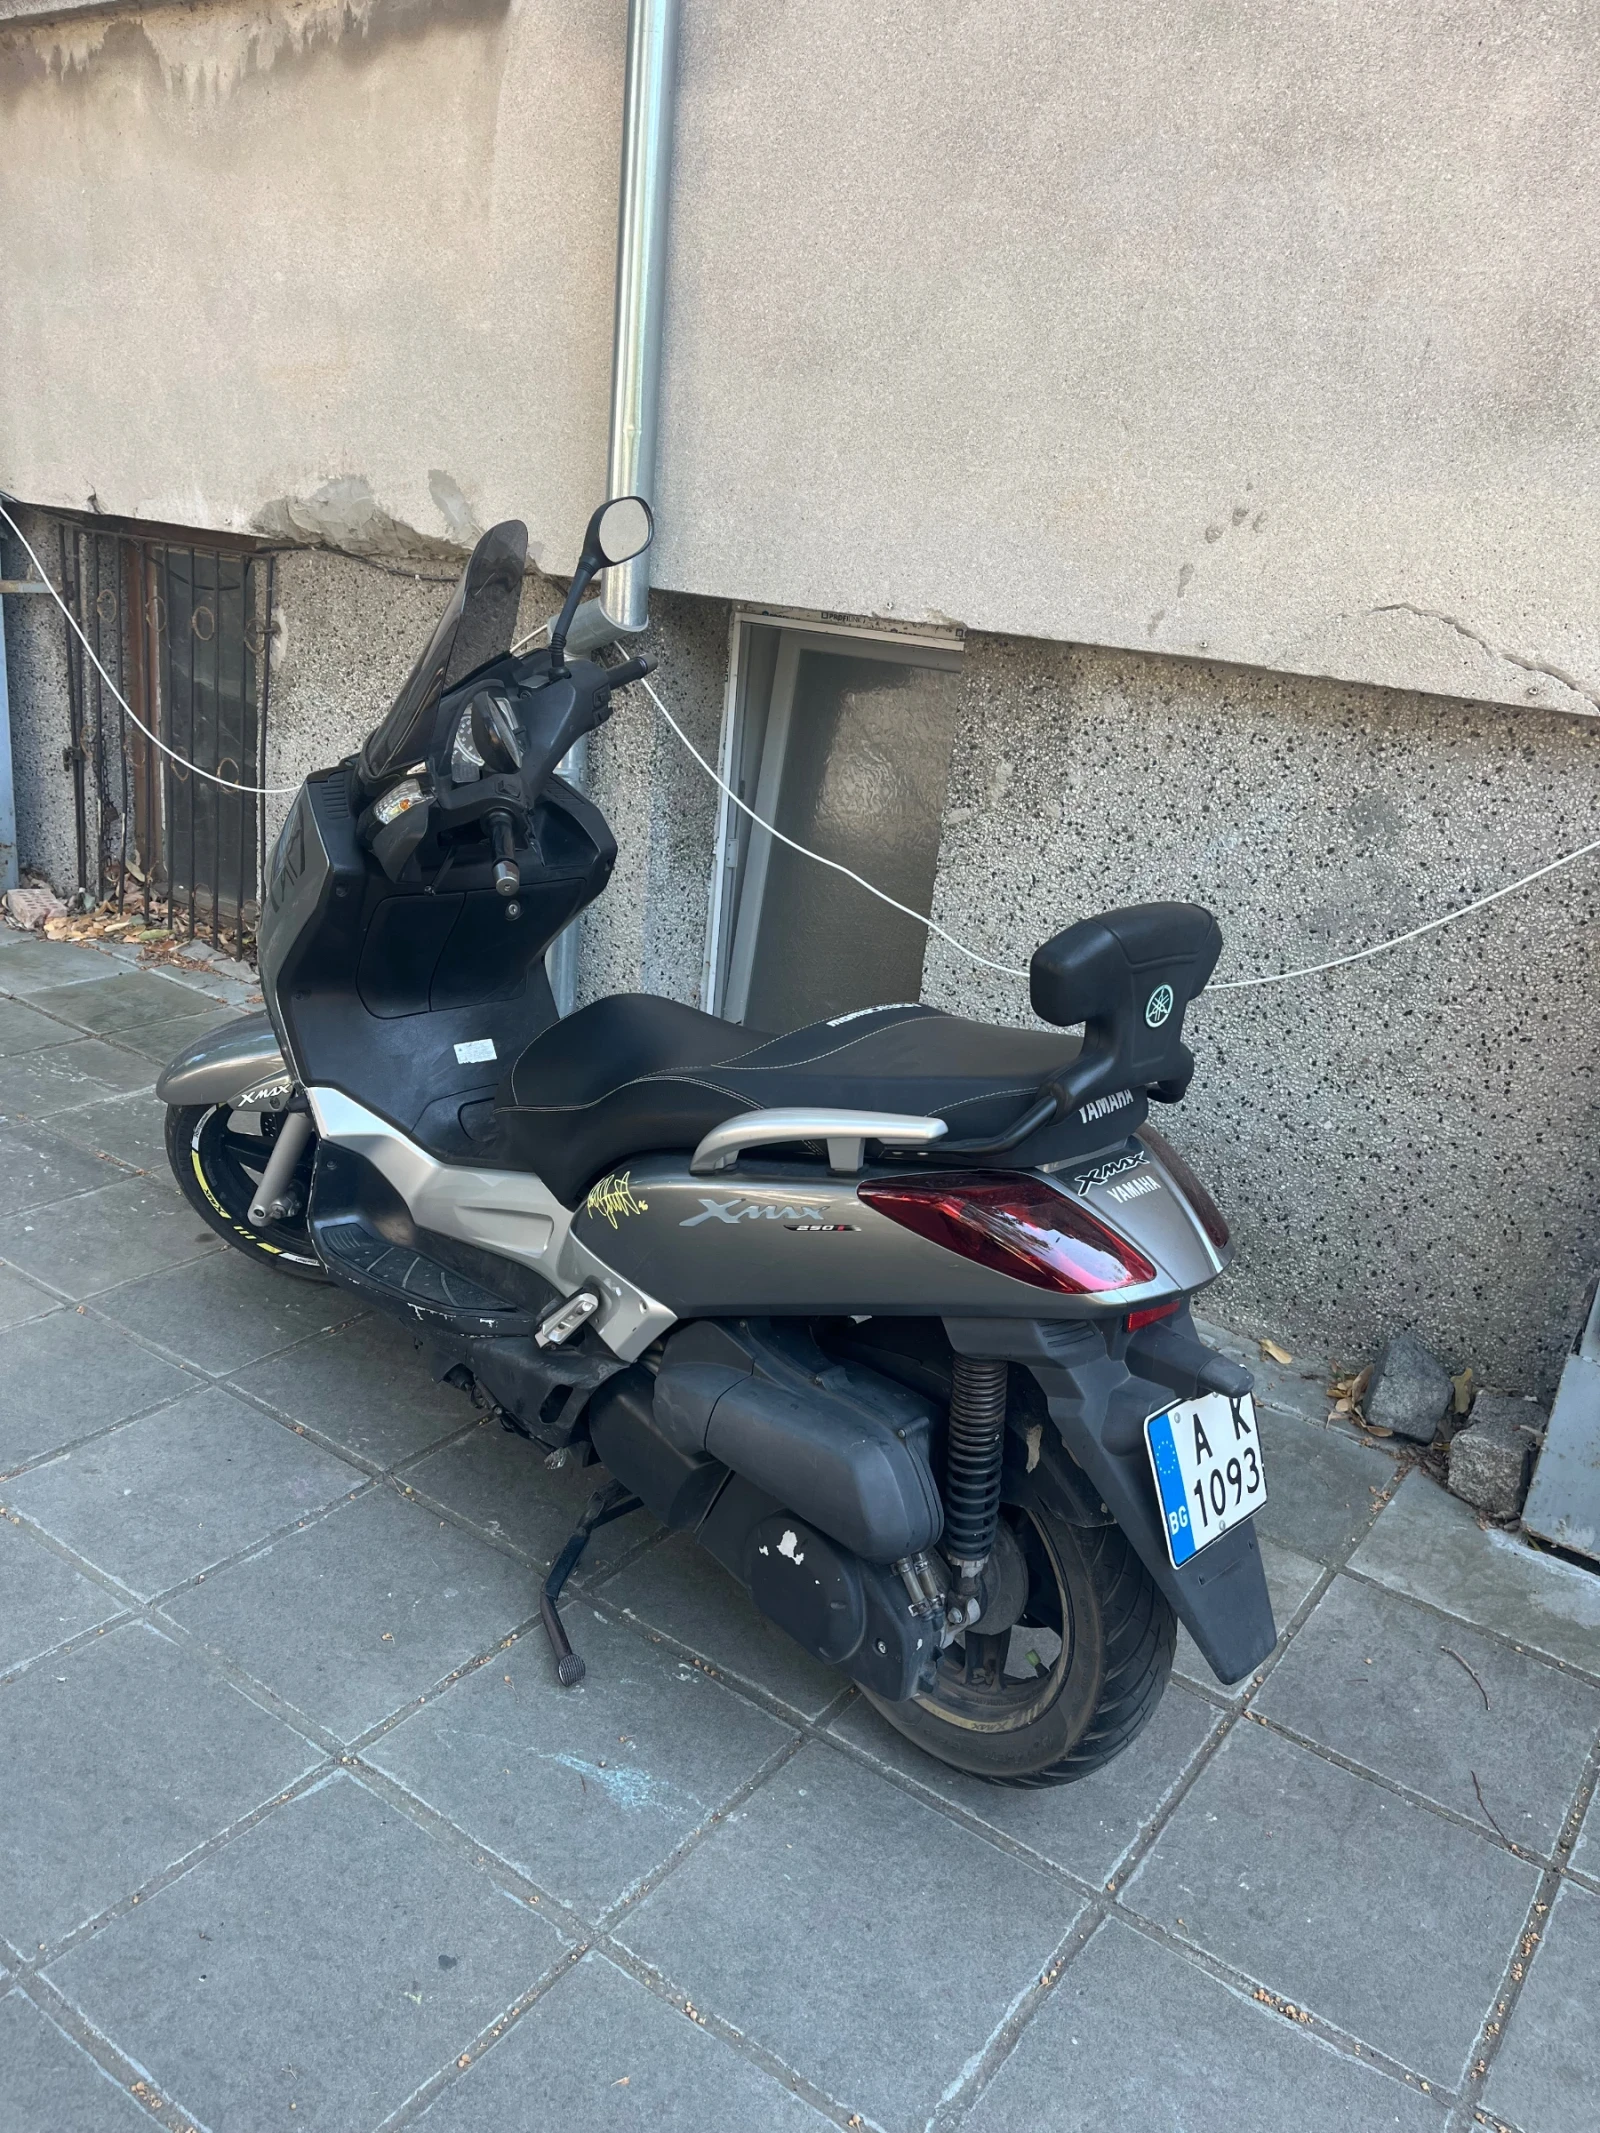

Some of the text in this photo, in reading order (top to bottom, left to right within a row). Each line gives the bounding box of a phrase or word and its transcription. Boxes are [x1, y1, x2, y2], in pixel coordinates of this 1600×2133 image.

[1079, 1089, 1134, 1124] YAMAHA
[1074, 1150, 1150, 1196] XMAX
[1107, 1175, 1162, 1203] YAMAHA
[1192, 1396, 1252, 1466] A K
[1194, 1446, 1260, 1528] 1093
[1168, 1505, 1188, 1536] BG
